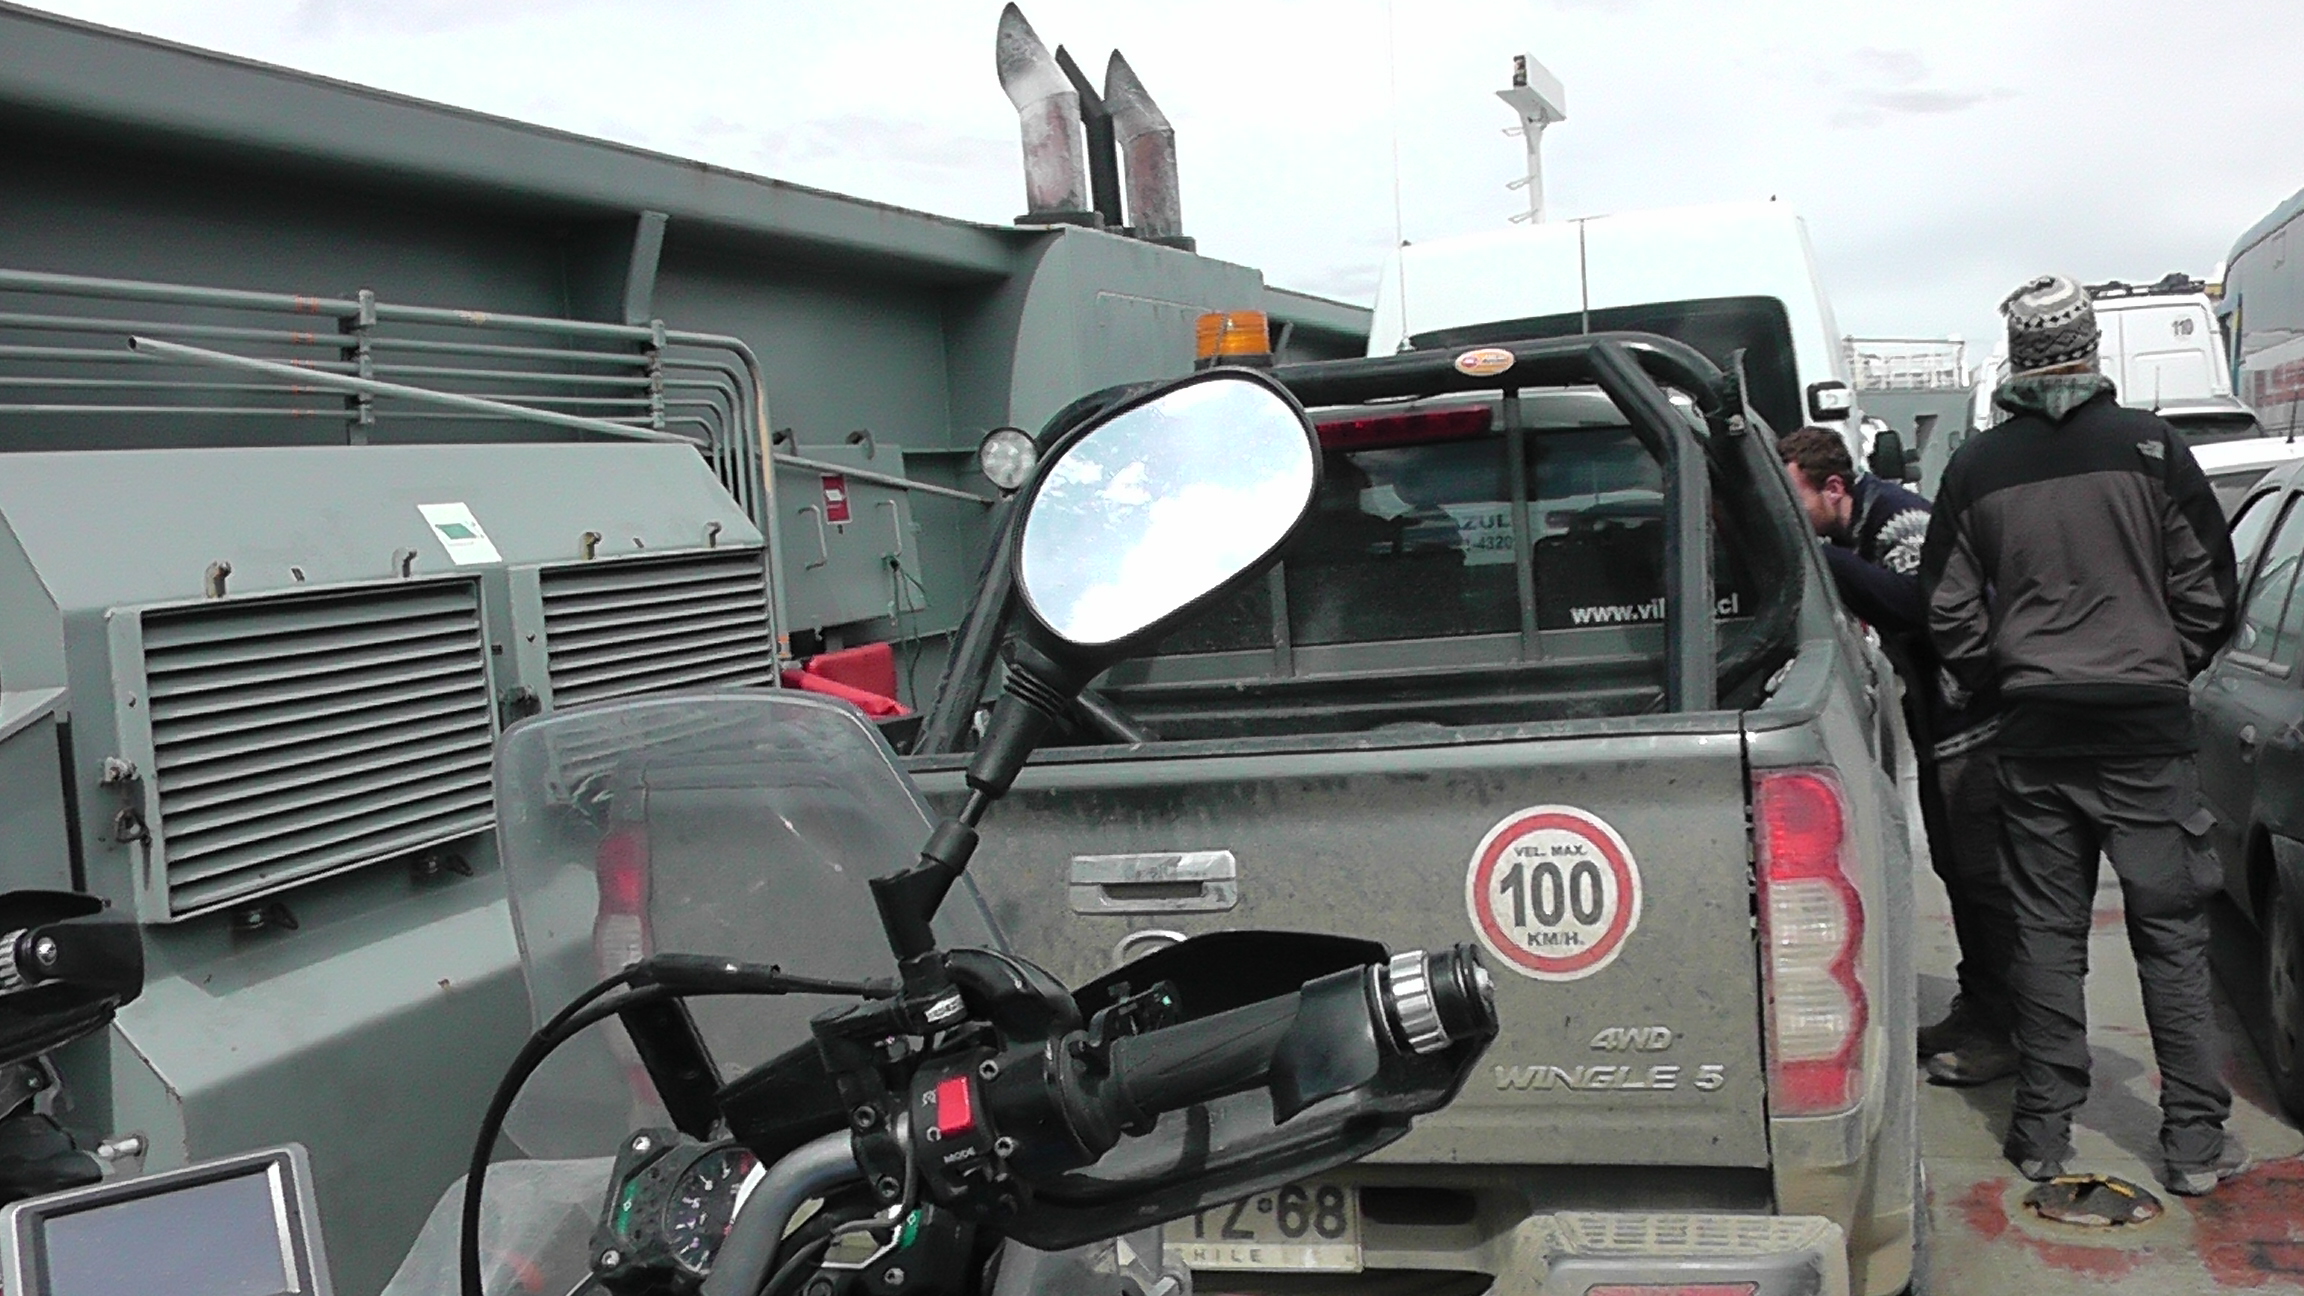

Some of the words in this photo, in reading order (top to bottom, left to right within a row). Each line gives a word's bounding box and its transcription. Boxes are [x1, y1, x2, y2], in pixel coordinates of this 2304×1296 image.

[1500, 860, 1604, 928] 100
[1590, 1026, 1673, 1052] 4WD
[1494, 1064, 1681, 1092] WINGLE
[1693, 1063, 1725, 1092] 5
[943, 1146, 976, 1164] MODE
[1192, 1247, 1264, 1264] HILE
